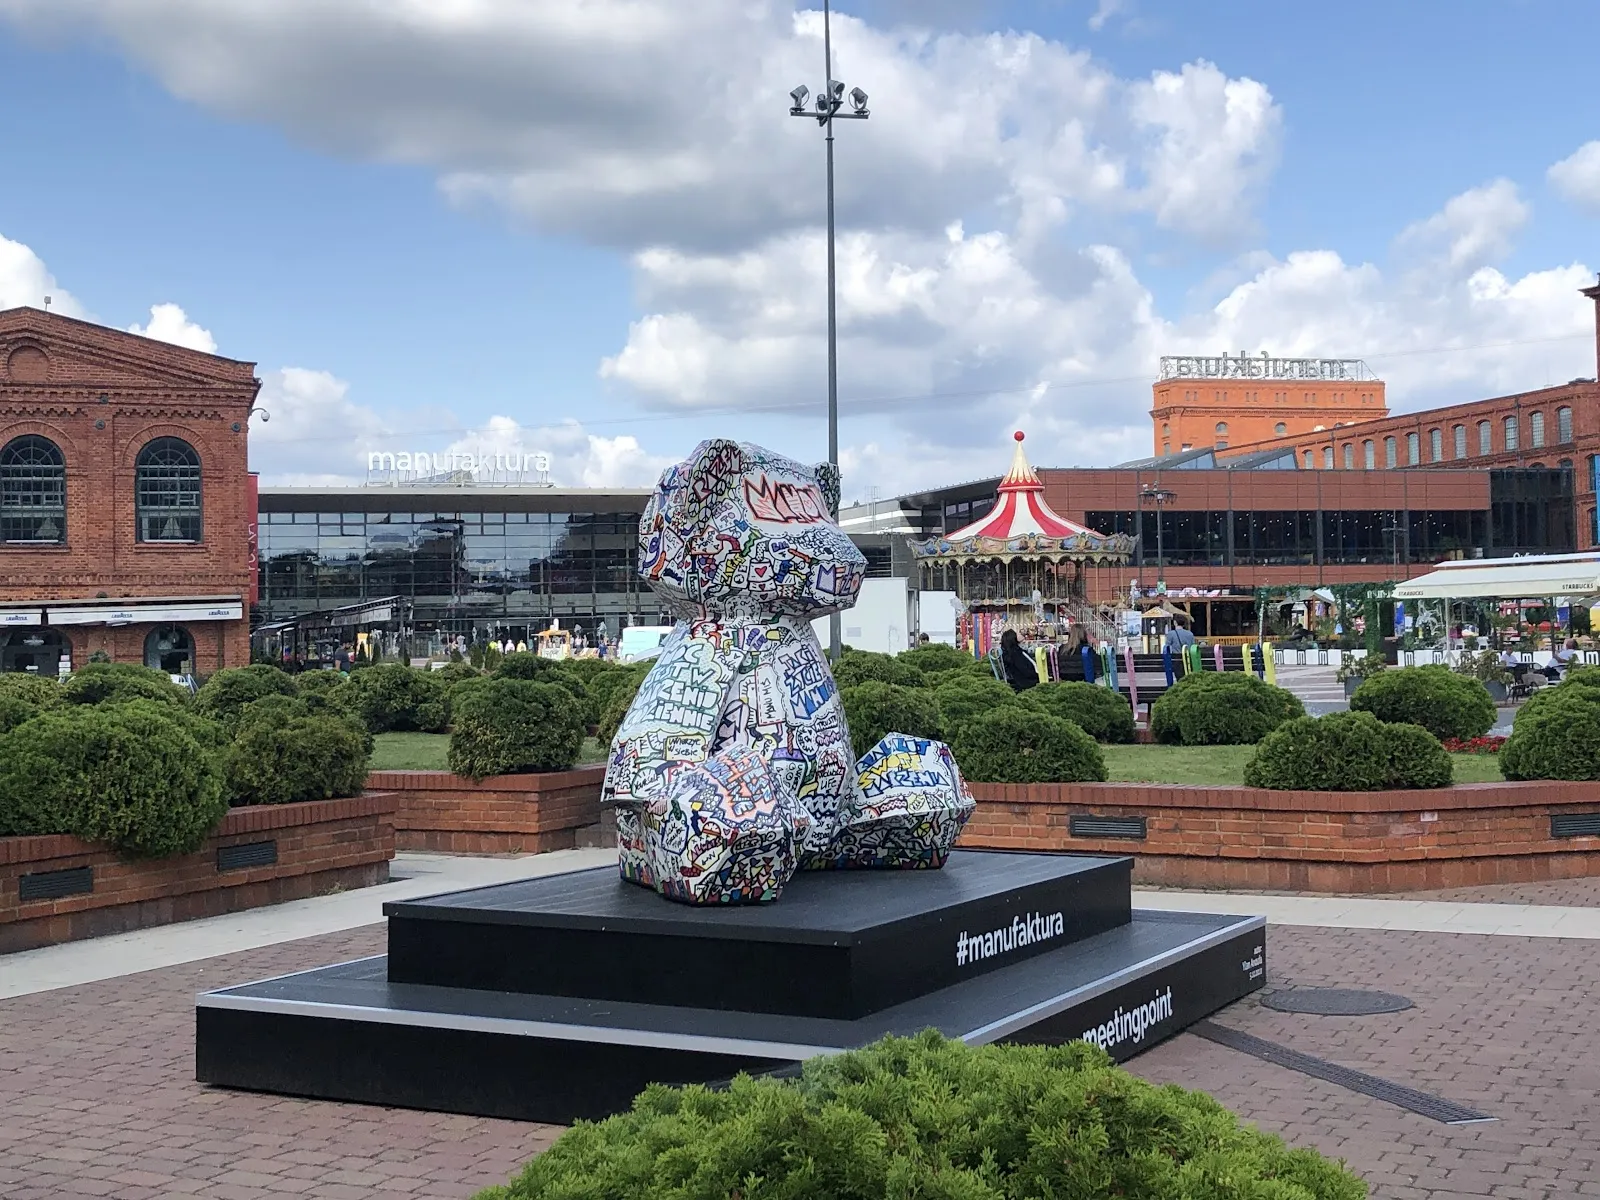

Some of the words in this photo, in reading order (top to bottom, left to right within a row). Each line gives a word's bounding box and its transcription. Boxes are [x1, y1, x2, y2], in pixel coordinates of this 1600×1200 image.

[368, 447, 550, 472] manufaktura
[957, 911, 1064, 966] #manufaktura
[1083, 985, 1173, 1051] meetingpoint
